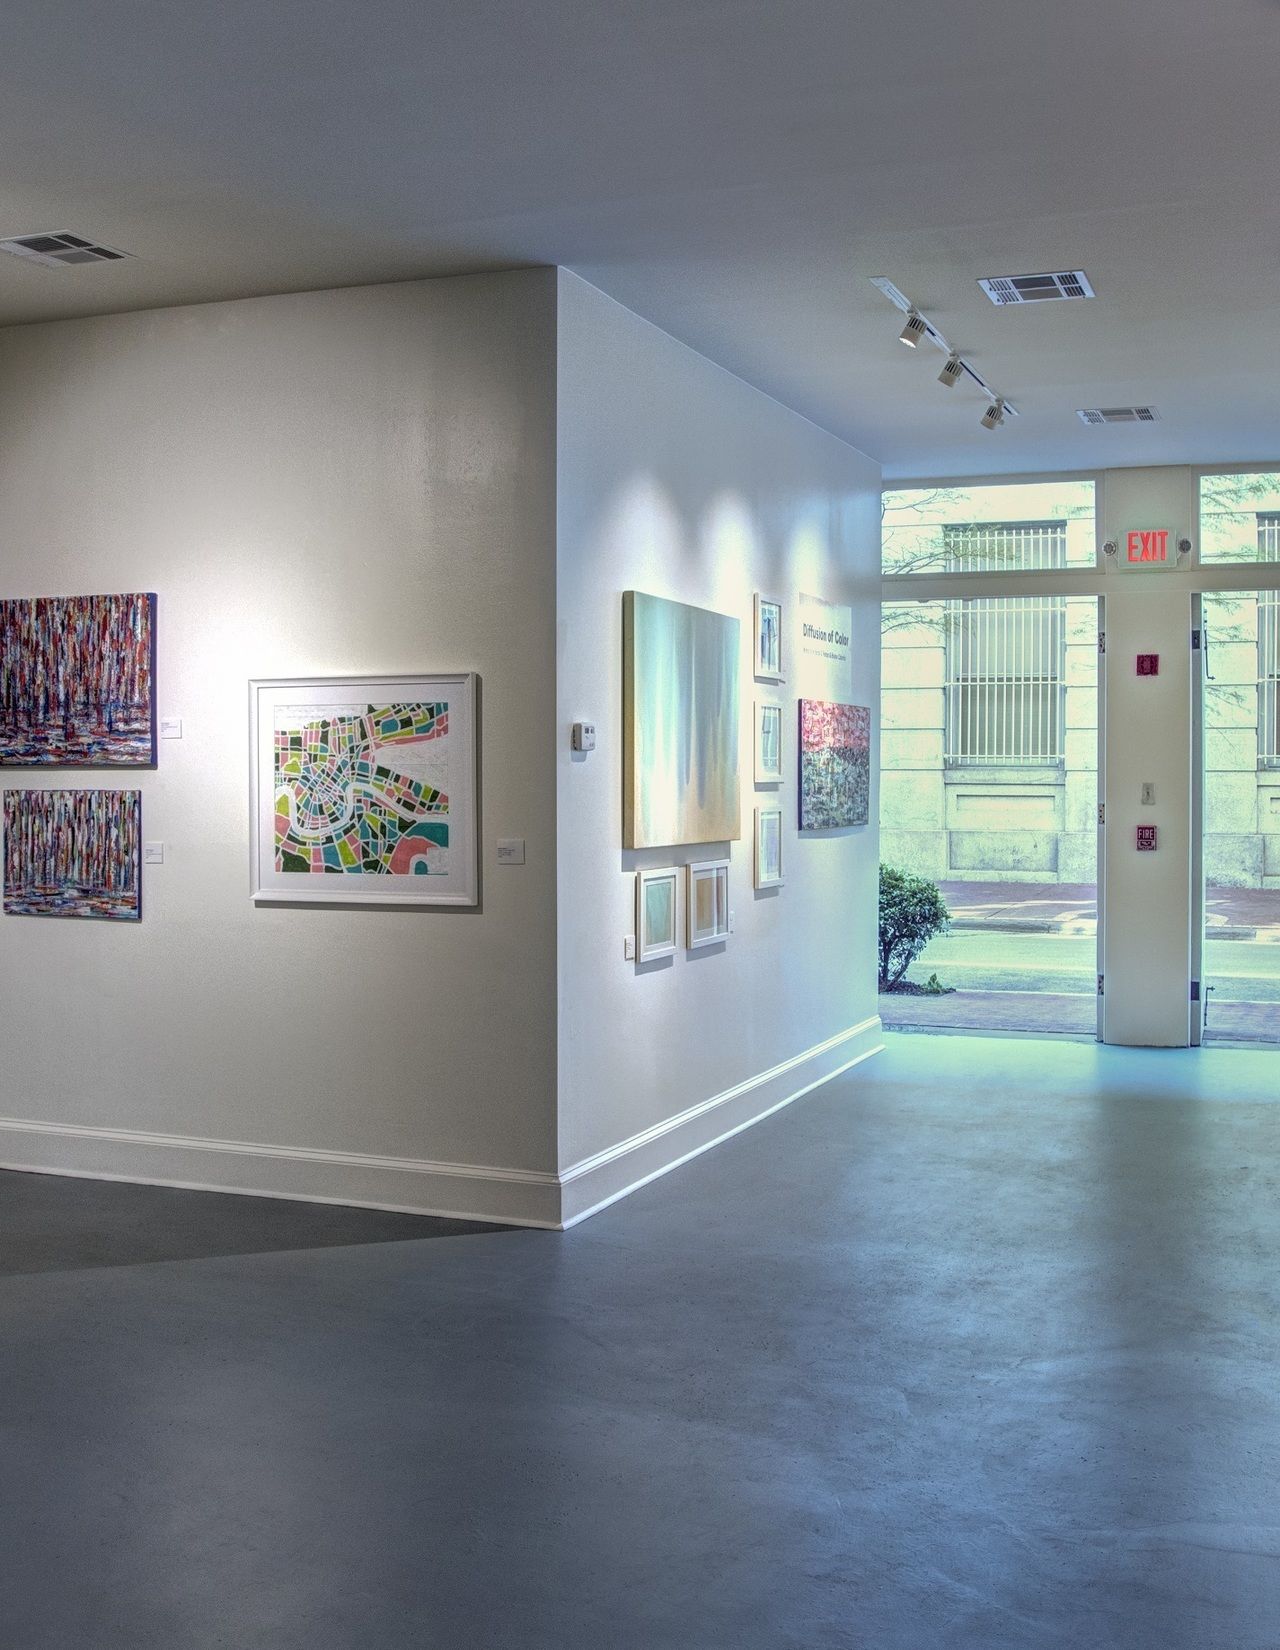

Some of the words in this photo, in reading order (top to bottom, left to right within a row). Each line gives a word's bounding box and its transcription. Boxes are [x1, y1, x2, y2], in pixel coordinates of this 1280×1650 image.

[1127, 531, 1168, 561] EXIT
[803, 623, 827, 642] Diffusion
[827, 630, 834, 643] of
[835, 631, 849, 646] Color
[1138, 828, 1154, 839] FIRE
